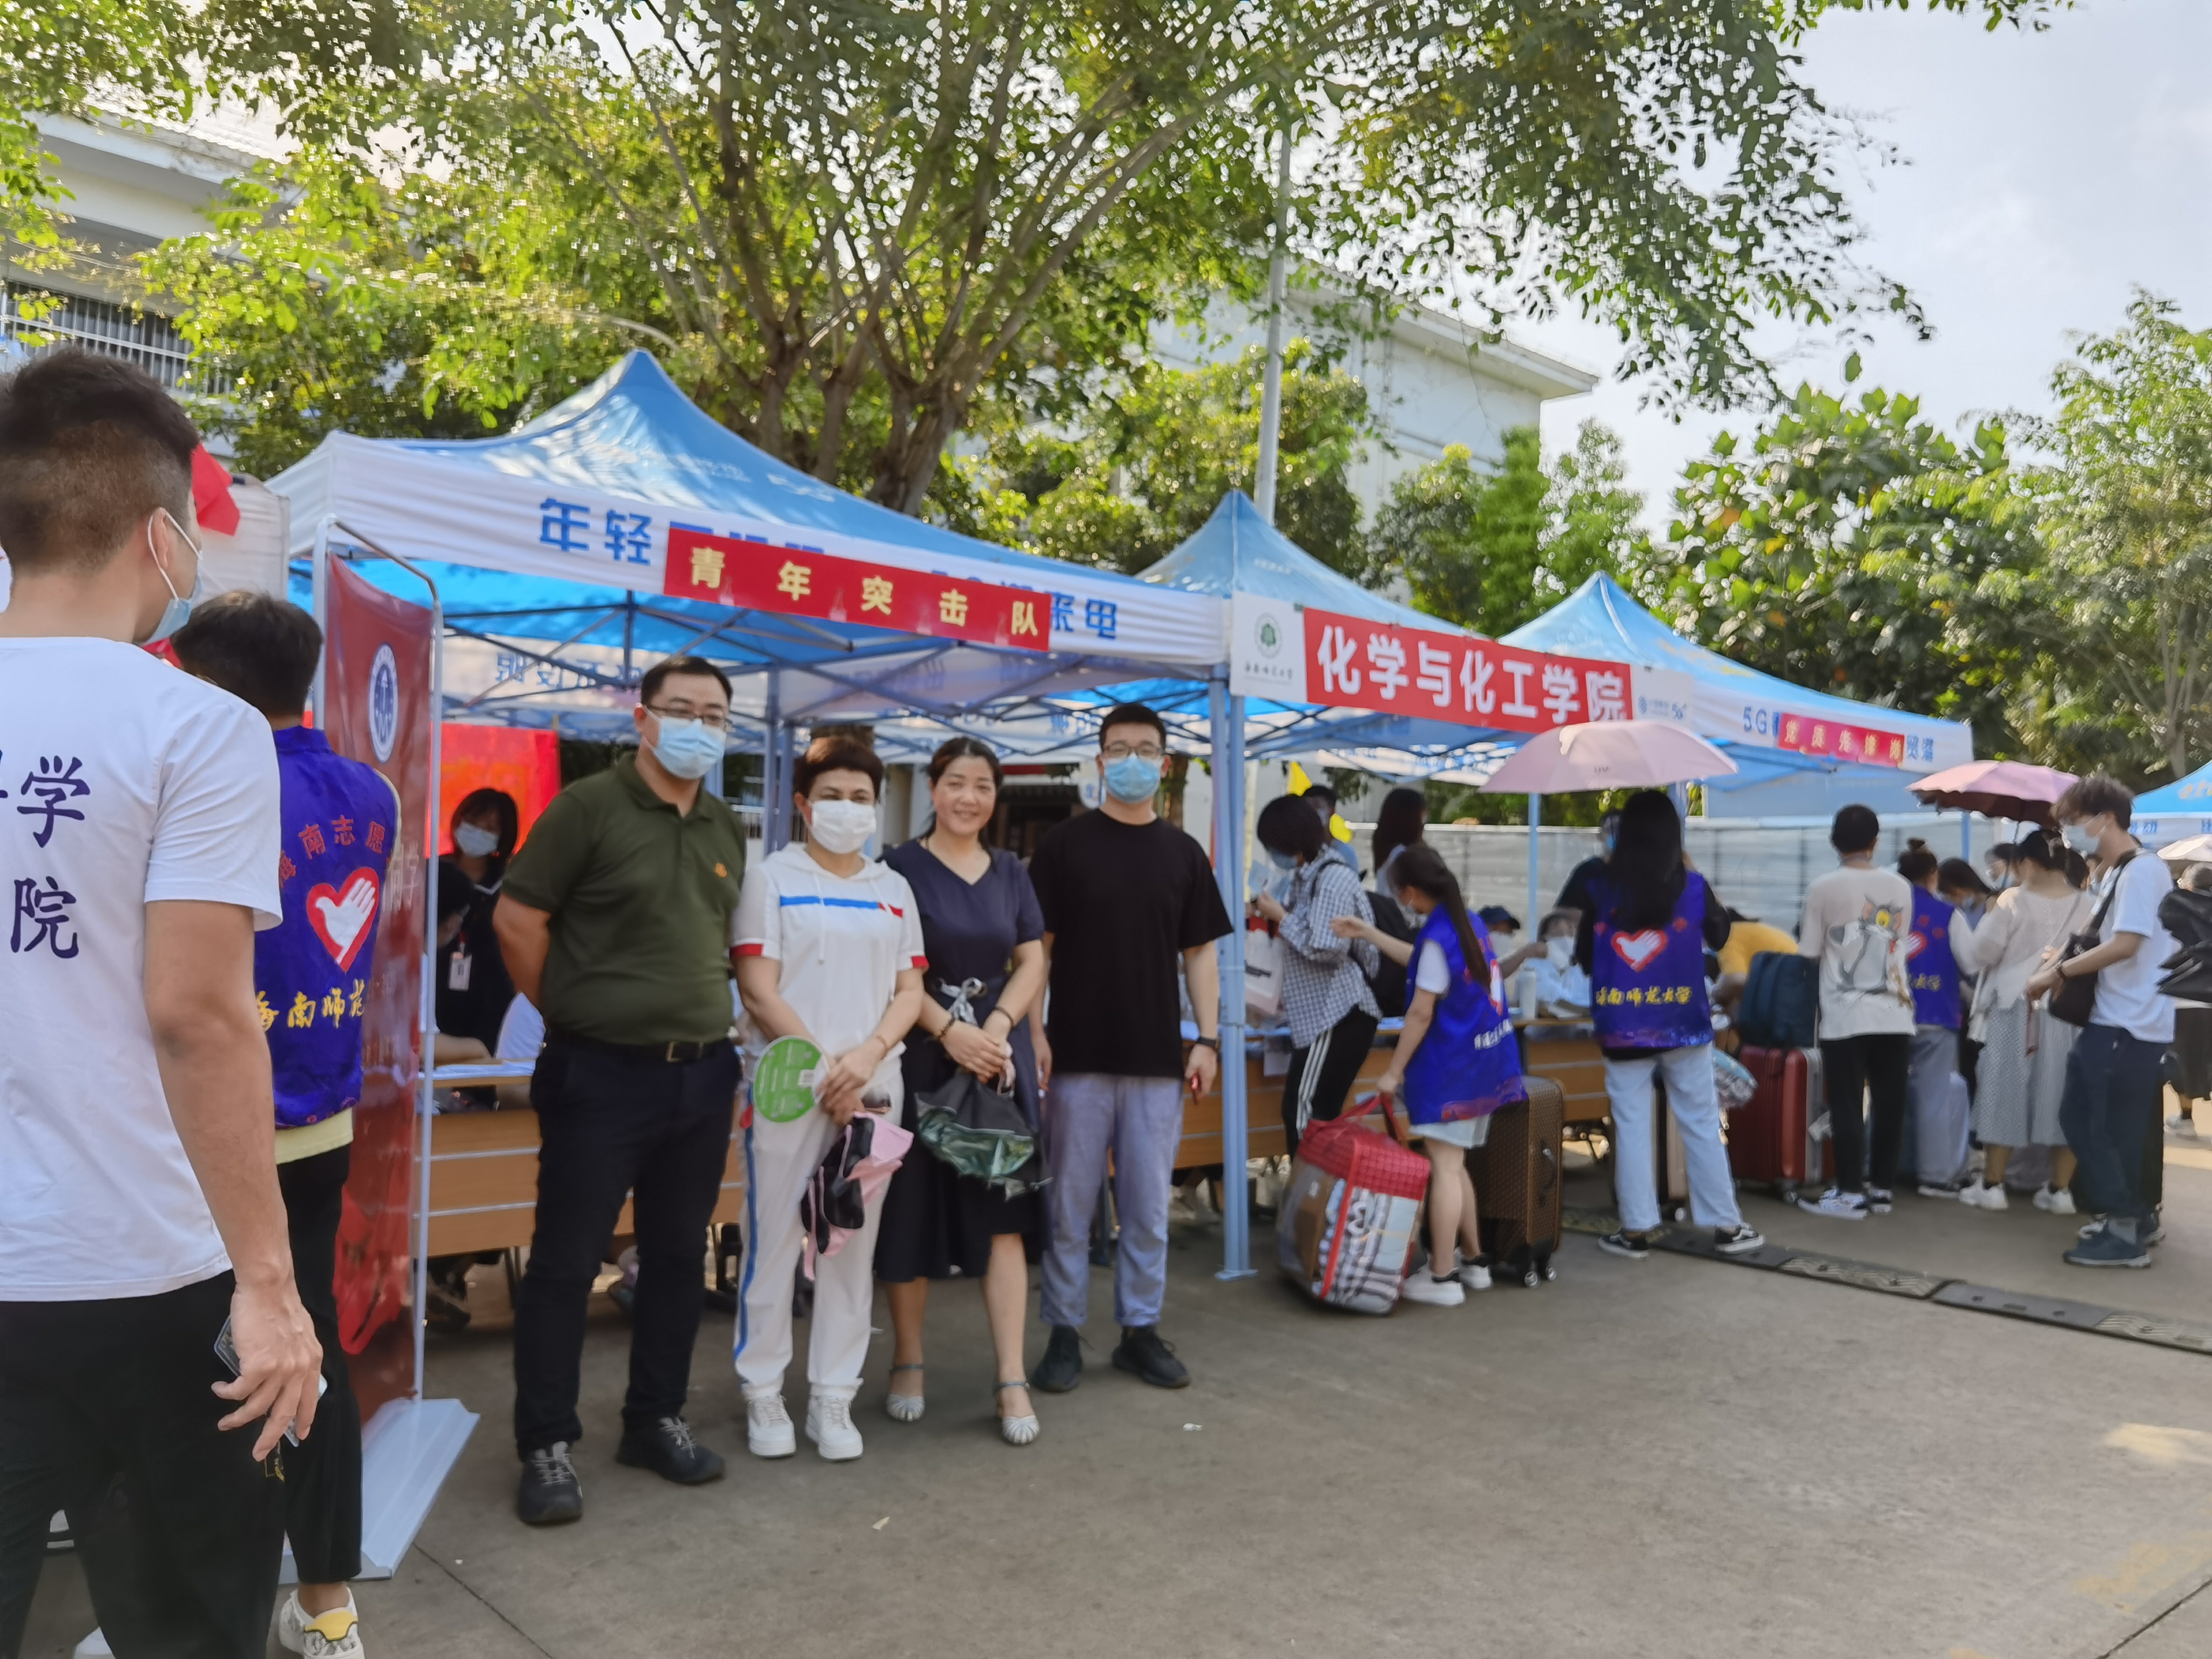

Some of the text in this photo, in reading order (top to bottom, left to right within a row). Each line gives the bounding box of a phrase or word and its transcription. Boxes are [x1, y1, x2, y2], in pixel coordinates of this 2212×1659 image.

[540, 498, 652, 566] 年轻
[690, 546, 1038, 636] 青年突击队
[1317, 624, 1627, 724] 化学与化工学院
[1743, 706, 1767, 734] 5G
[0, 749, 90, 848] 学
[11, 876, 79, 959] 院
